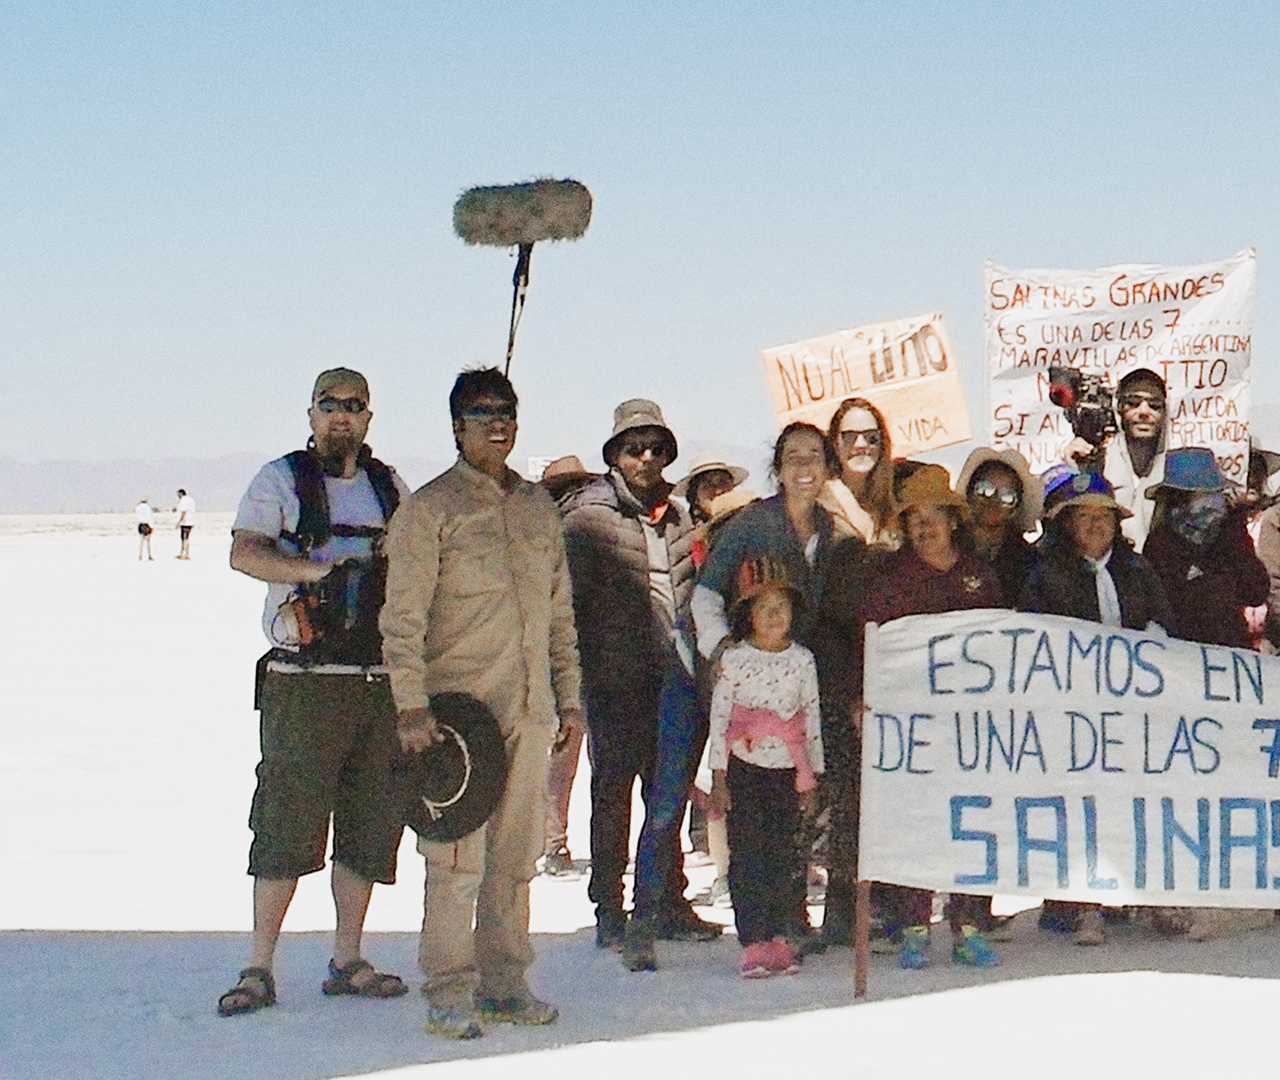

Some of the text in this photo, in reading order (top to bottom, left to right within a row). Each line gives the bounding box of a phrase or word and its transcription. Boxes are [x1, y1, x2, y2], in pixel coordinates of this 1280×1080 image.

[990, 273, 1225, 310] SALINAS GRANDES
[997, 318, 1027, 346] ES
[1041, 323, 1083, 345] UNA
[999, 346, 1139, 369] MARAVILLAS
[1158, 358, 1227, 390] ITIO
[776, 353, 825, 410] NO
[899, 415, 948, 443] VIDA
[994, 404, 1030, 438] SI
[928, 627, 1167, 700] ESTAMOS
[1201, 649, 1265, 705] EN
[873, 713, 934, 775] DE
[955, 709, 1046, 775] UNA
[1064, 711, 1124, 774] DE
[1143, 714, 1224, 776] LAS
